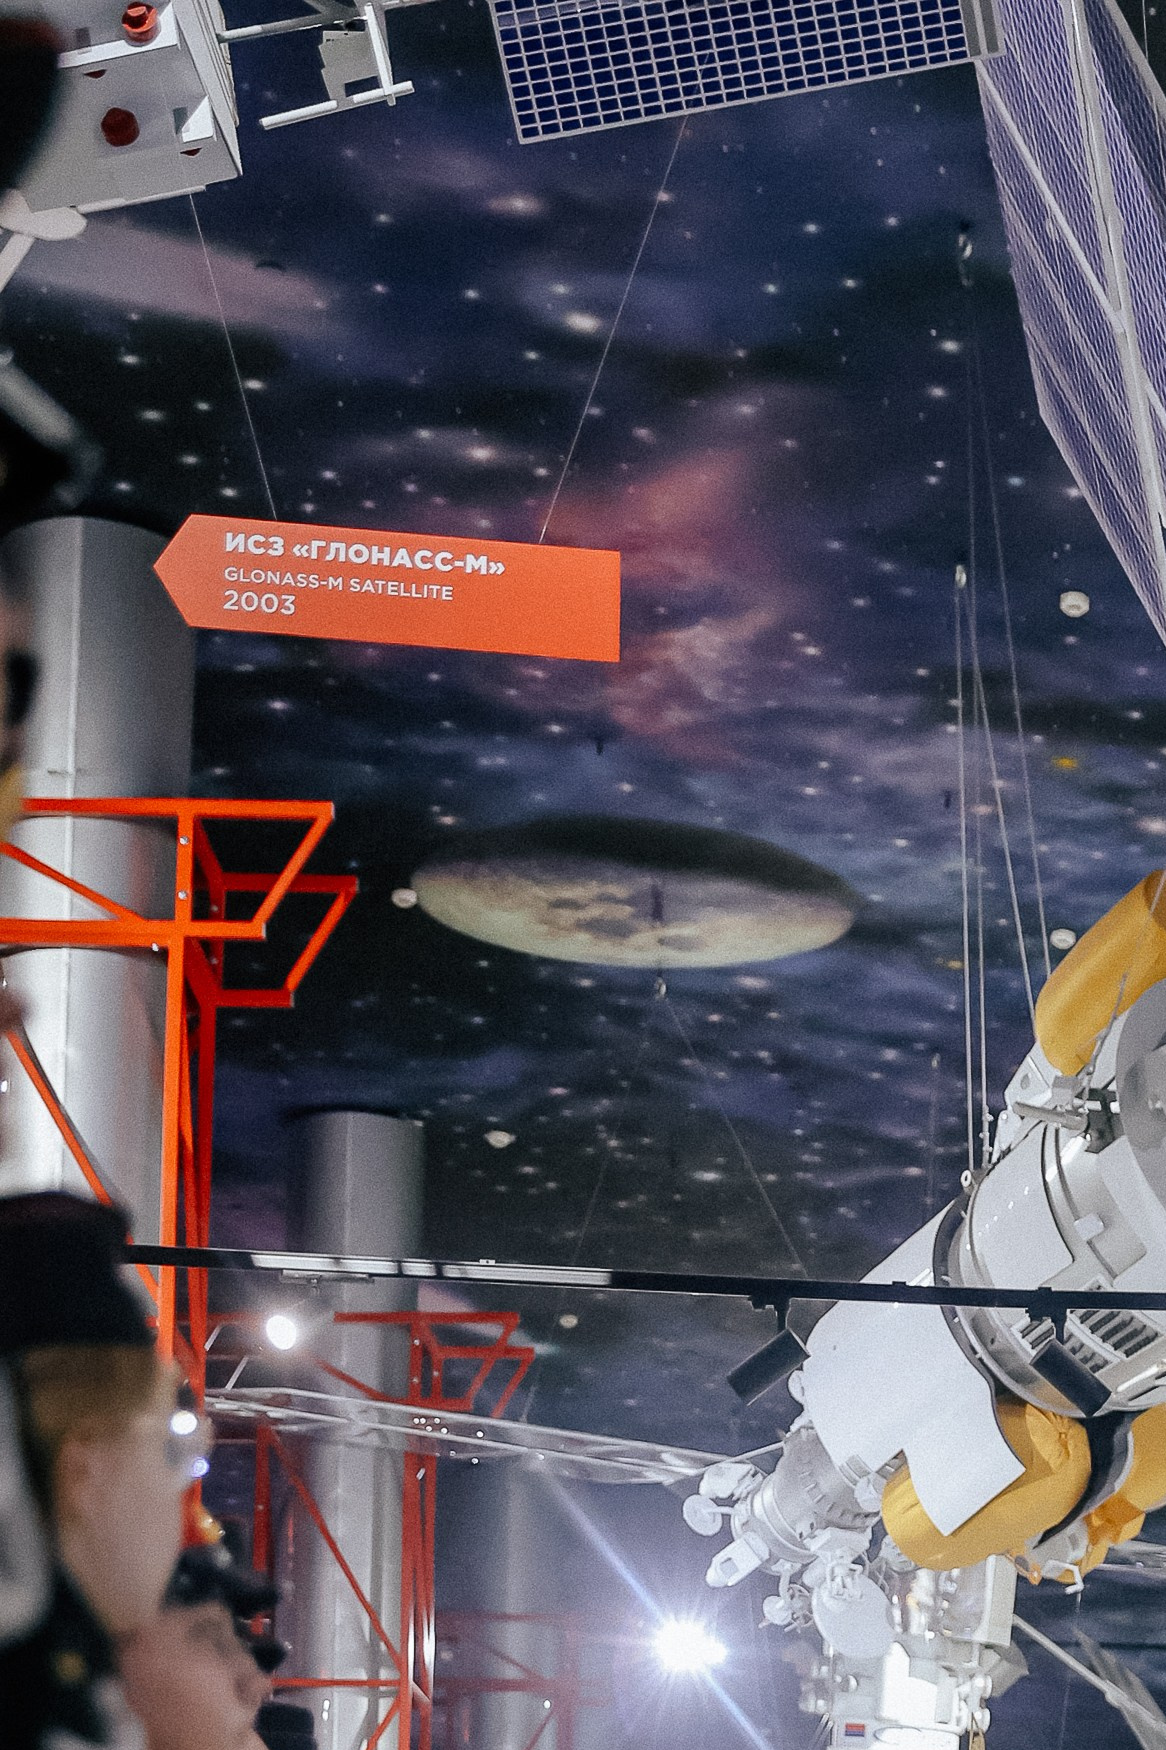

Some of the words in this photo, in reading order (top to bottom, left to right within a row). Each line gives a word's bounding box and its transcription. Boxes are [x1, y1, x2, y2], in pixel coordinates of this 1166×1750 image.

[225, 532, 284, 557] ИСЗ
[293, 540, 506, 575] «ГЛОНАСС-М»
[224, 566, 344, 591] GLONASS-M
[349, 578, 454, 601] SATELLITE
[223, 589, 296, 615] 2003
